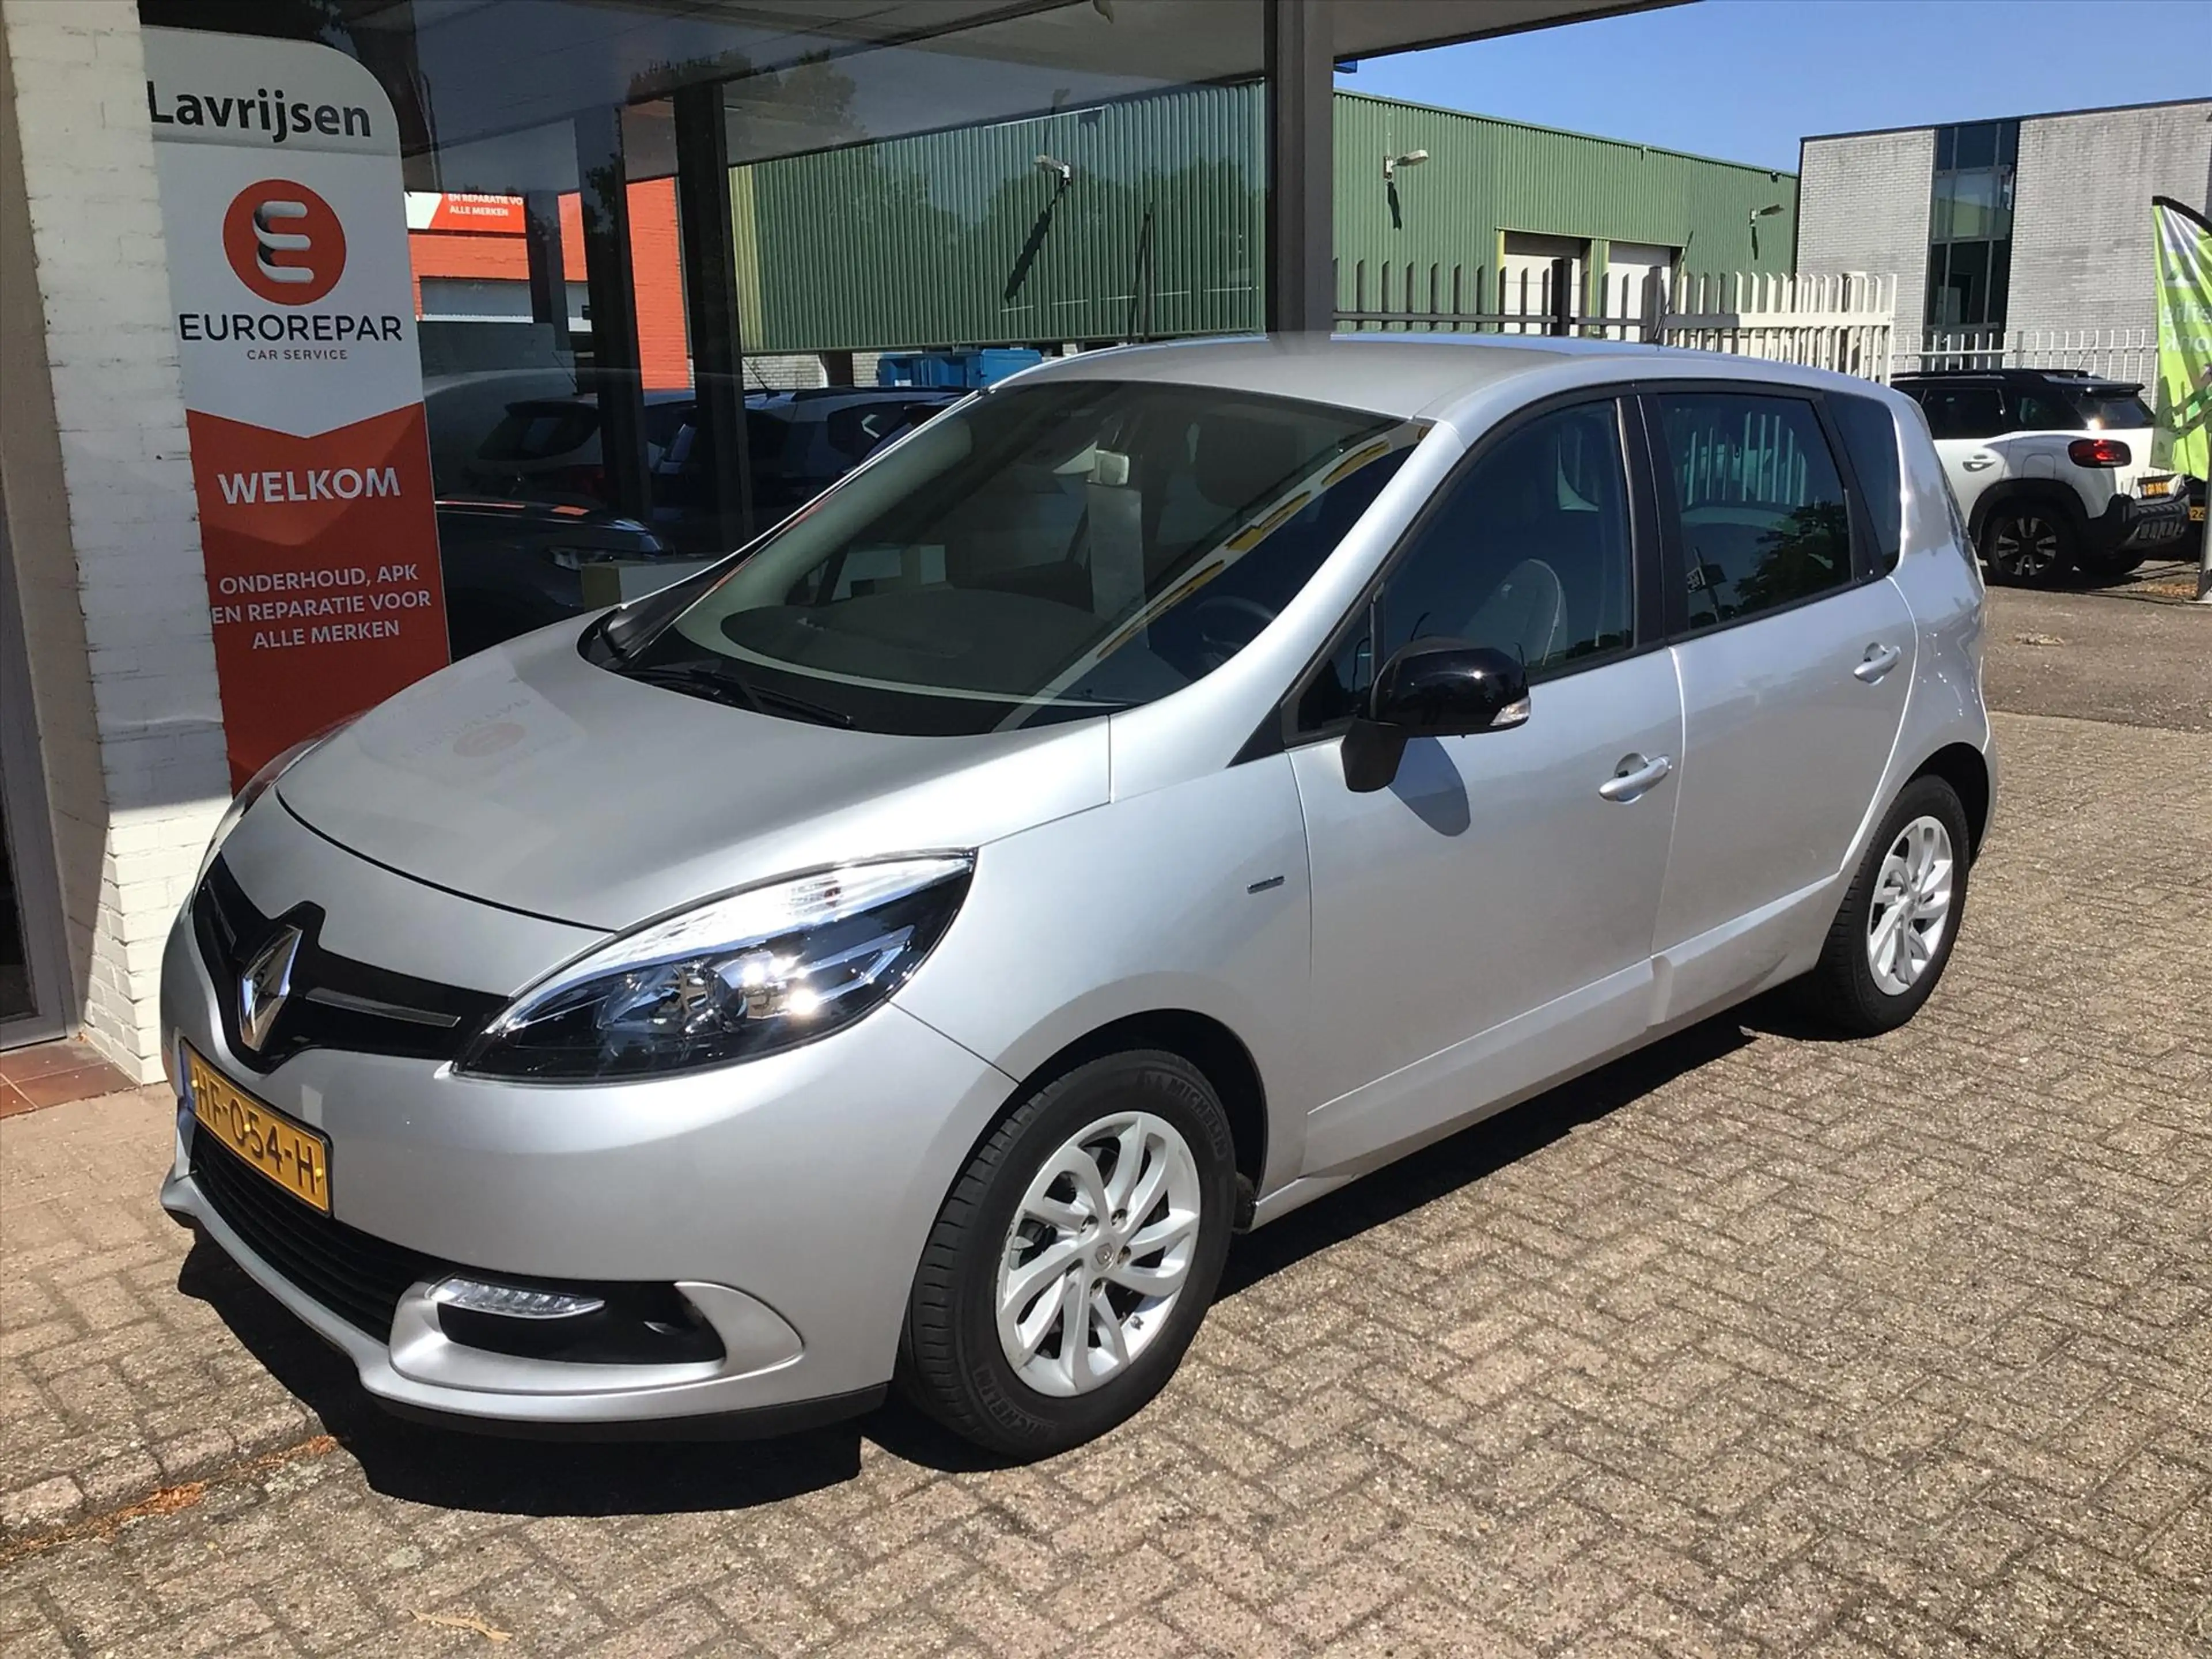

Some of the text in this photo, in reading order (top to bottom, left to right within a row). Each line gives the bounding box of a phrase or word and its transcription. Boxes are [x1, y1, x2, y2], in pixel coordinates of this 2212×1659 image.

[146, 81, 372, 143] Lavrijsen
[449, 205, 509, 217] ALLE MERKEN
[179, 313, 403, 342] EUROREPAR
[247, 349, 348, 361] CAR SERVICE
[218, 467, 401, 504] WELKOM
[219, 563, 419, 595] ONDERHOUD, APK
[211, 589, 432, 625] EN REPARATIE VOOR
[252, 620, 399, 650] ALLE MERKEN
[195, 1066, 317, 1195] HF-054-H
